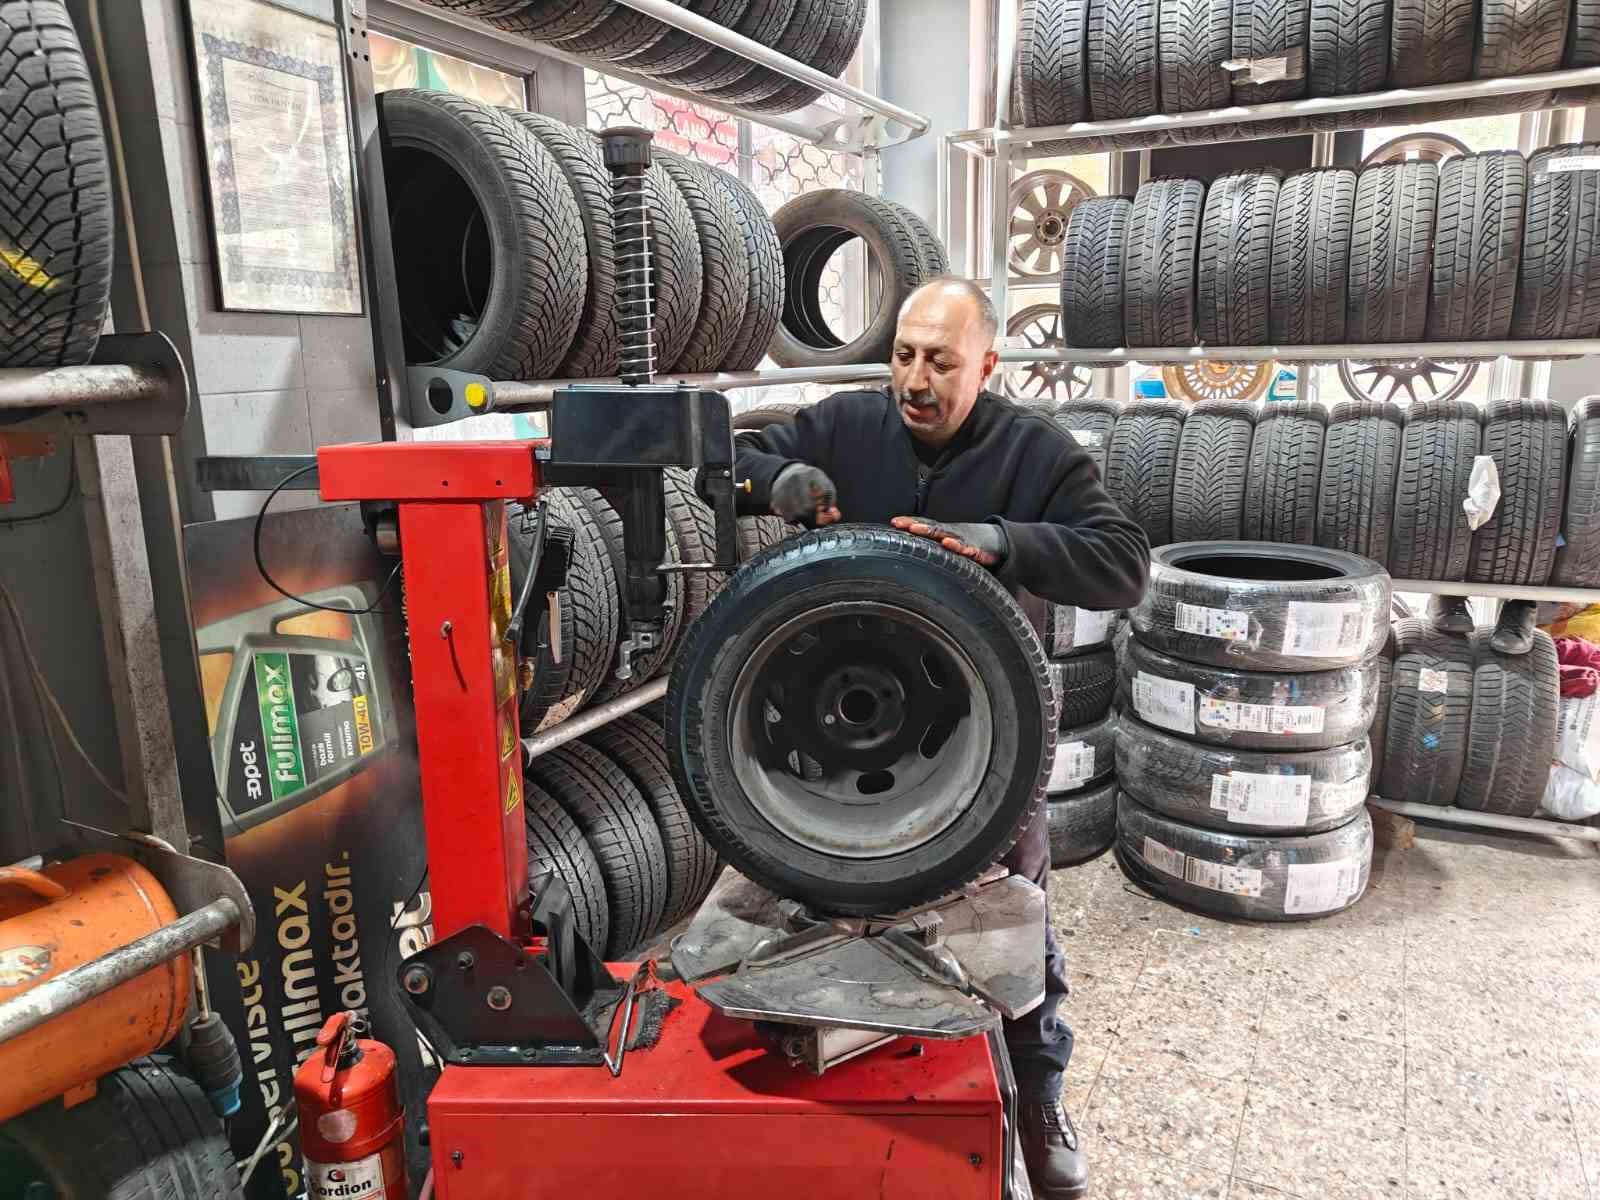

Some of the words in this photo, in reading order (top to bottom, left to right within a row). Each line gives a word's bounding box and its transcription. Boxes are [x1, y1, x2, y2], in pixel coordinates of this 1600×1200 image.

[354, 663, 369, 681] 4L
[263, 663, 300, 783] fullmax
[354, 698, 374, 753] 10W-40
[239, 740, 262, 800] opet
[275, 879, 322, 1078] ullmax
